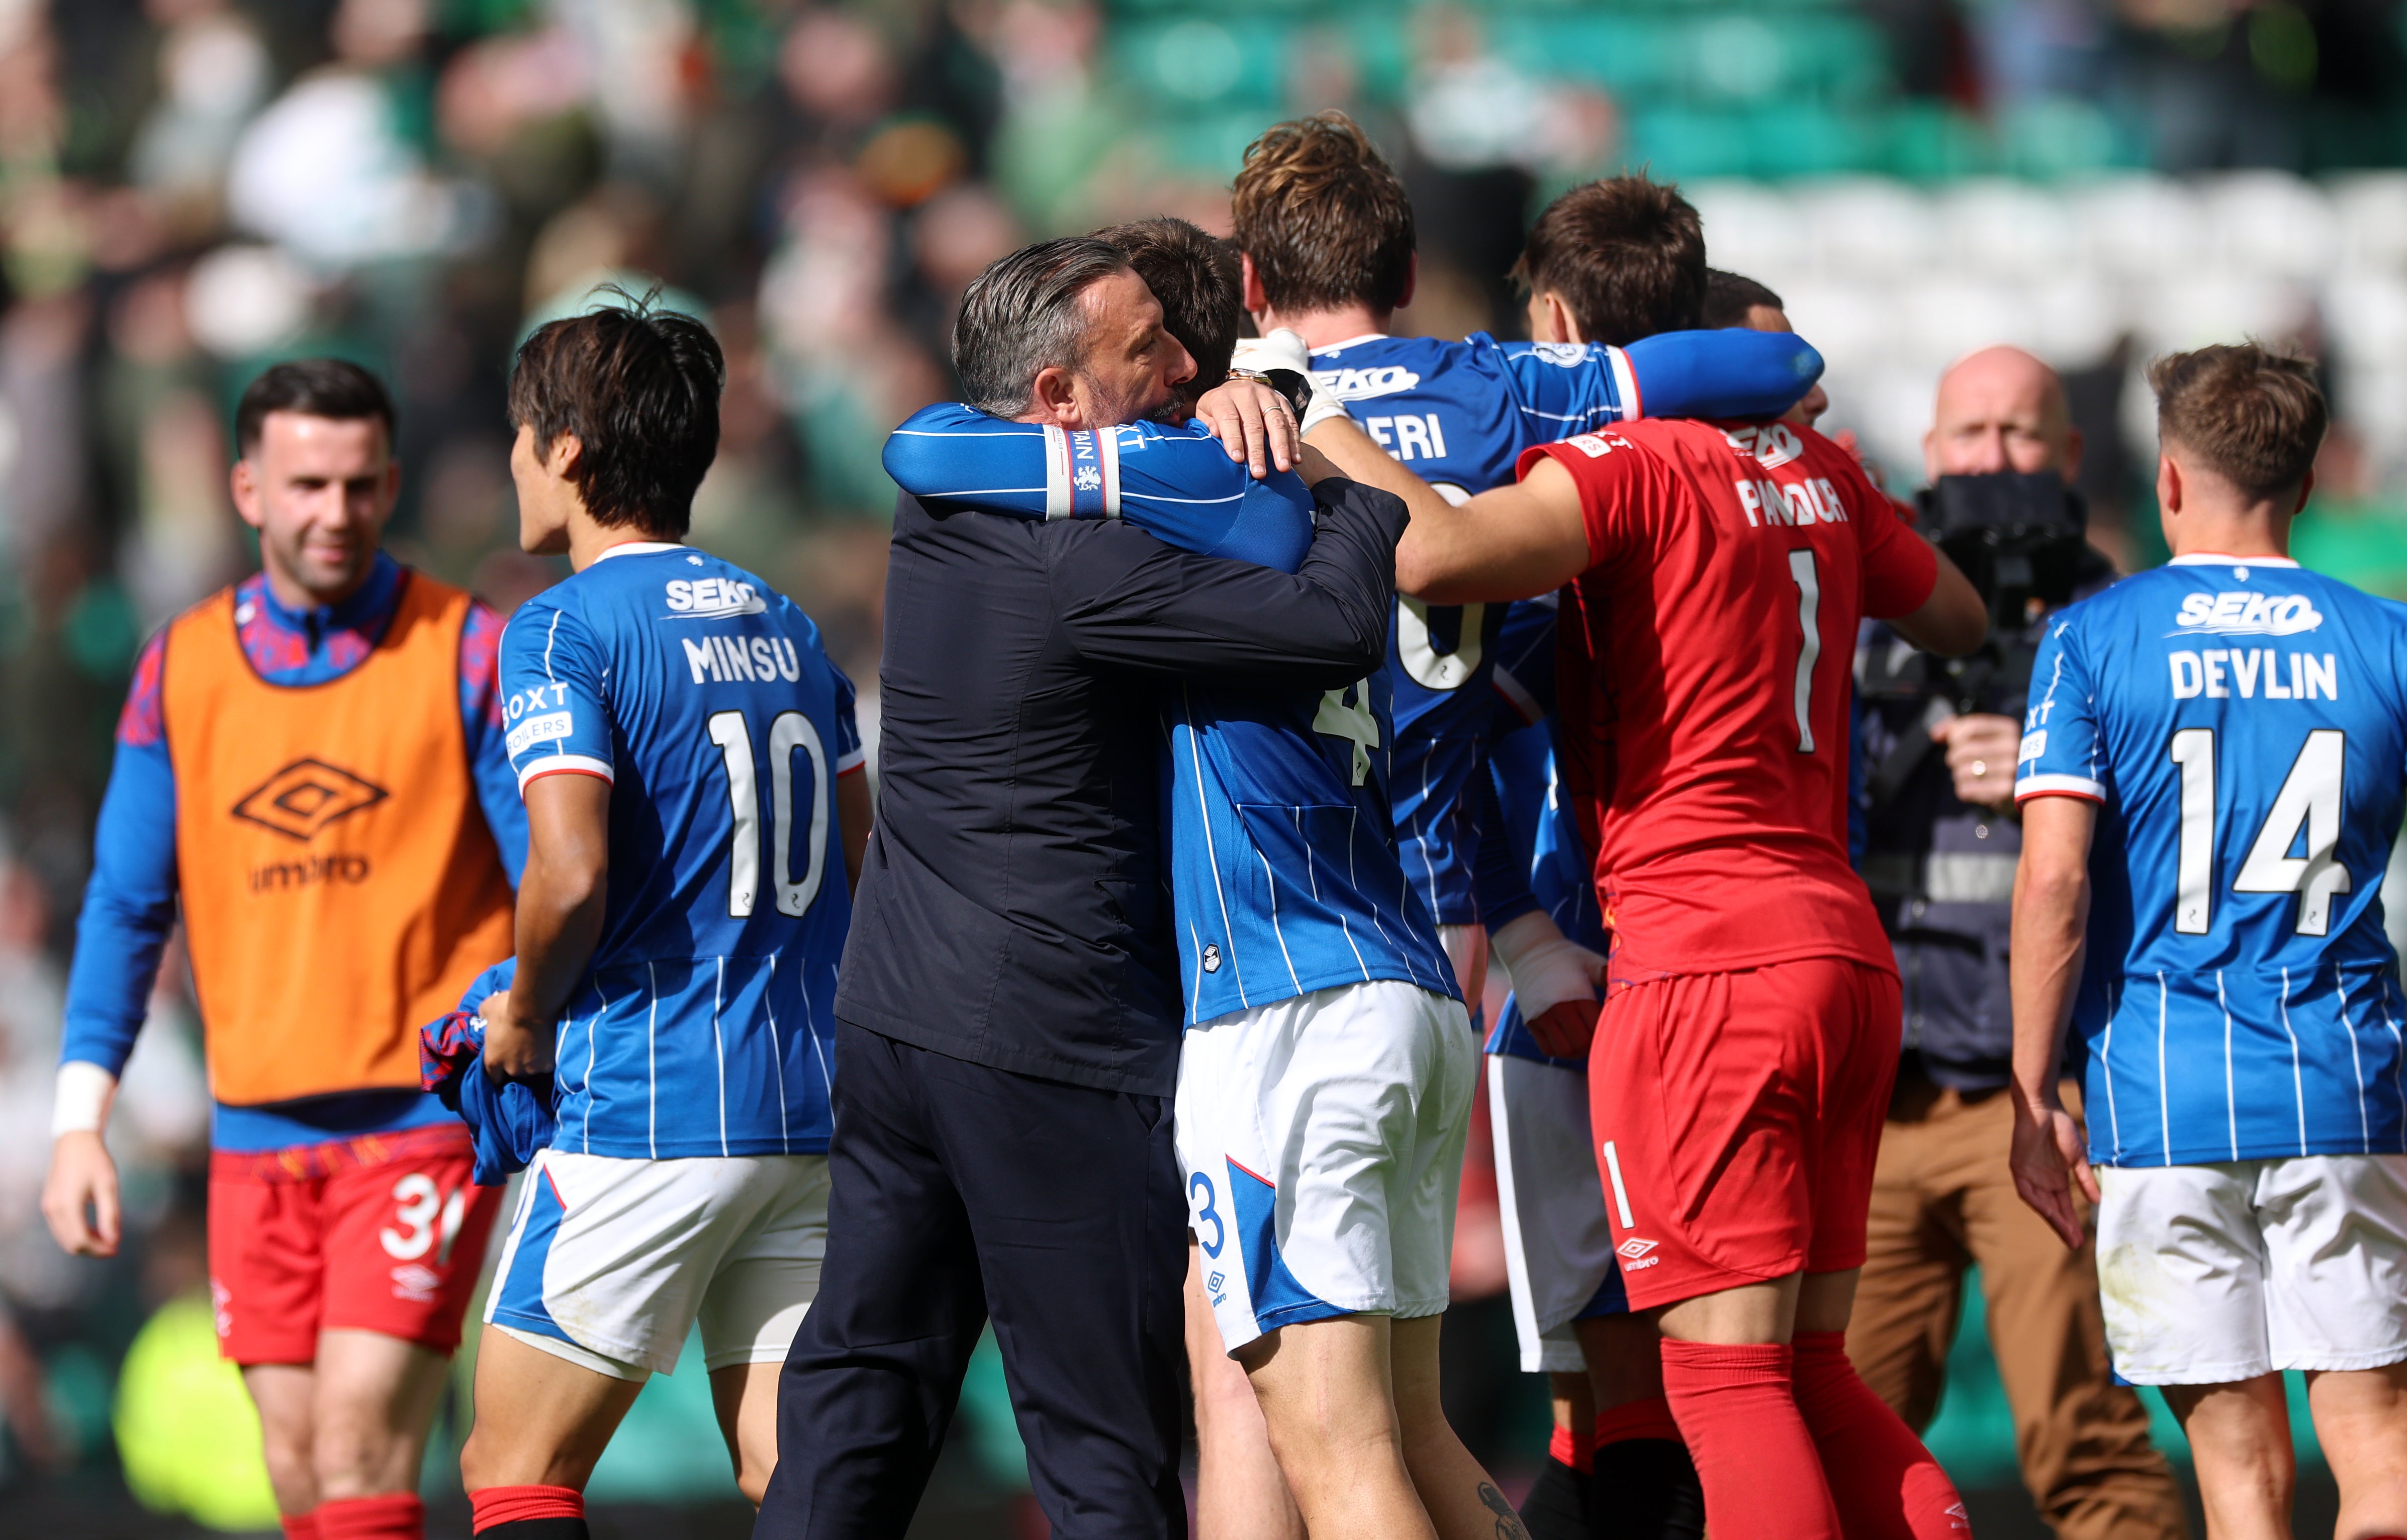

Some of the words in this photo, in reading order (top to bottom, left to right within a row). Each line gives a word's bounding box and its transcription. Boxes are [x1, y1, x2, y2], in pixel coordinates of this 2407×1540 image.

[1311, 365, 1421, 402] EKO
[1072, 430, 1094, 459] TAIN
[1116, 425, 1146, 449] XT
[1353, 413, 1447, 461] ERI
[665, 578, 768, 617] SEKO
[2176, 591, 2324, 634] SEKO
[681, 635, 801, 685] MINSU
[1788, 547, 1821, 753] 1
[2168, 648, 2338, 701] DEVLIN
[2024, 699, 2056, 732] XT
[707, 709, 829, 920] 10
[2171, 727, 2352, 936] 14
[1603, 1140, 1635, 1229] 1
[1624, 1255, 1659, 1272] umbro
